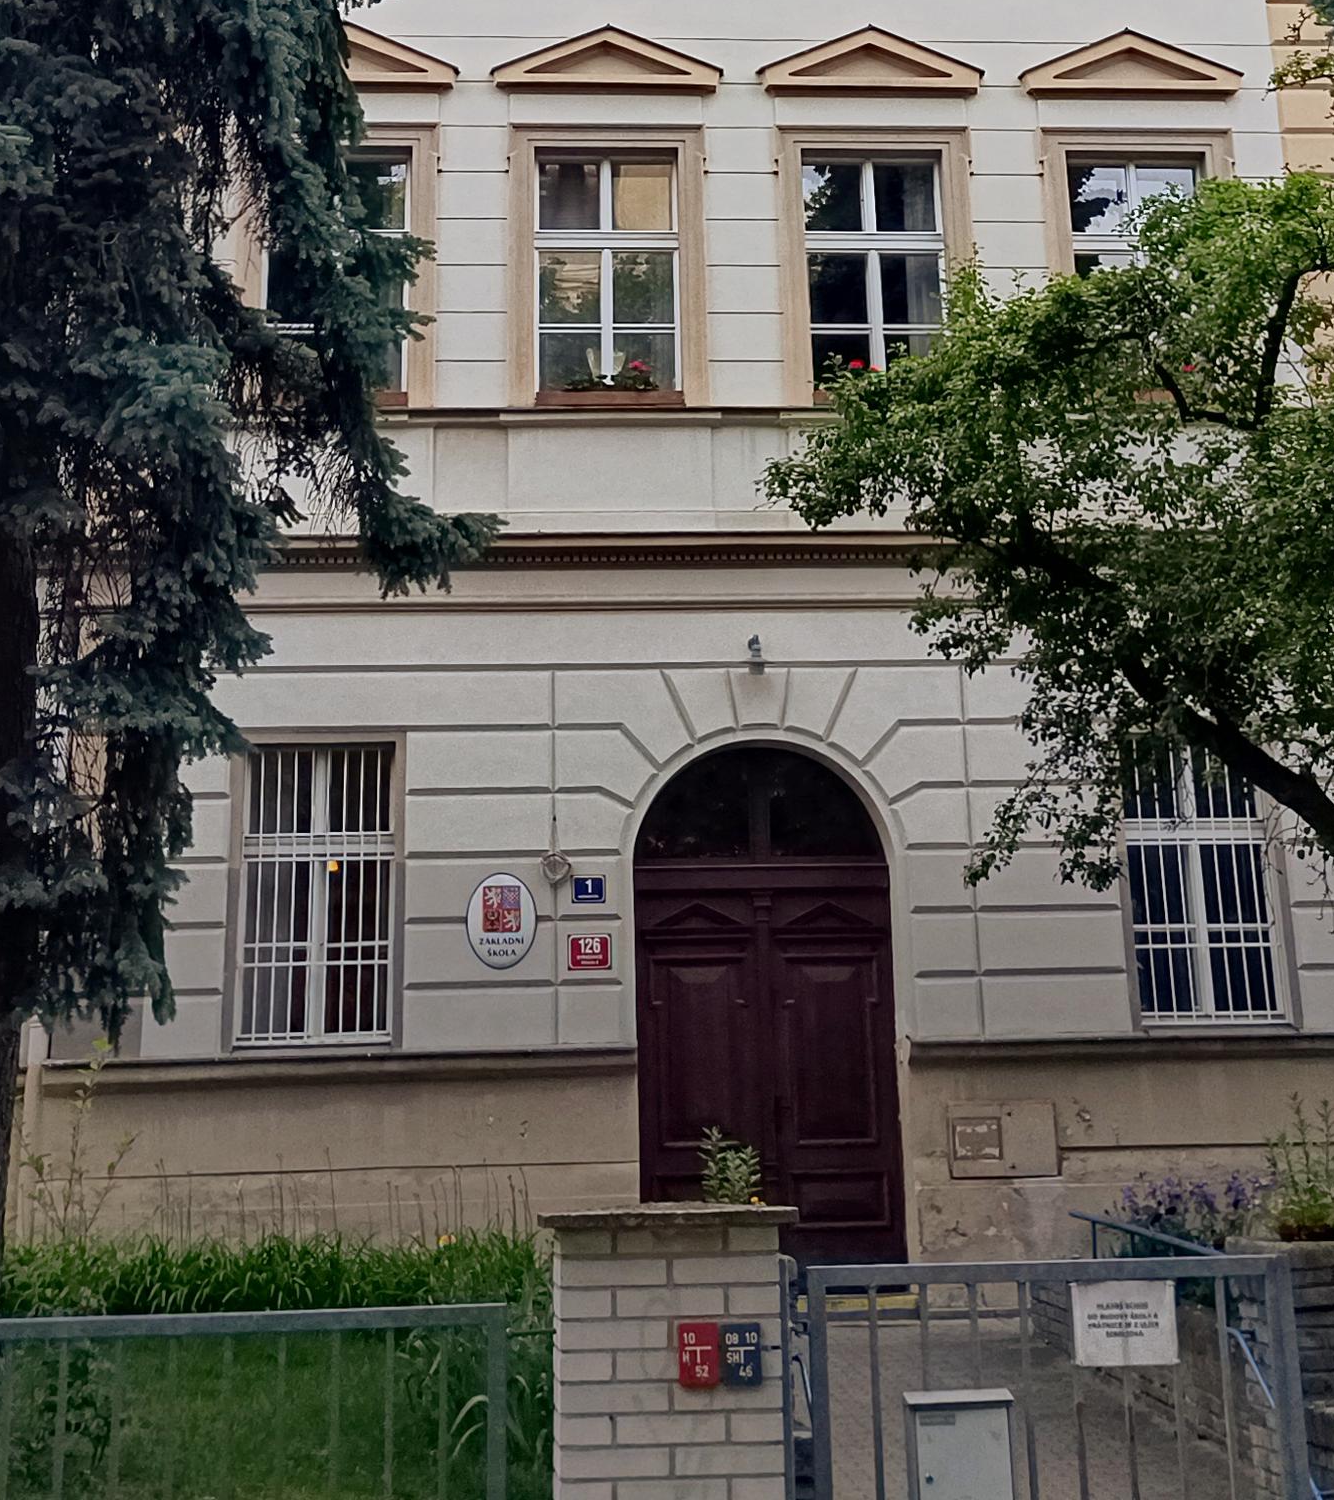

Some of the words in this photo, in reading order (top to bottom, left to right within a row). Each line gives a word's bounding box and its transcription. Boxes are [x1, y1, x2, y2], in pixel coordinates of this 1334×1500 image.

[585, 879, 592, 893] 1
[578, 937, 601, 954] 126
[487, 947, 517, 957] ŠKOLA
[682, 1332, 696, 1343] 10
[745, 1332, 757, 1344] 10
[695, 1365, 709, 1377] 52
